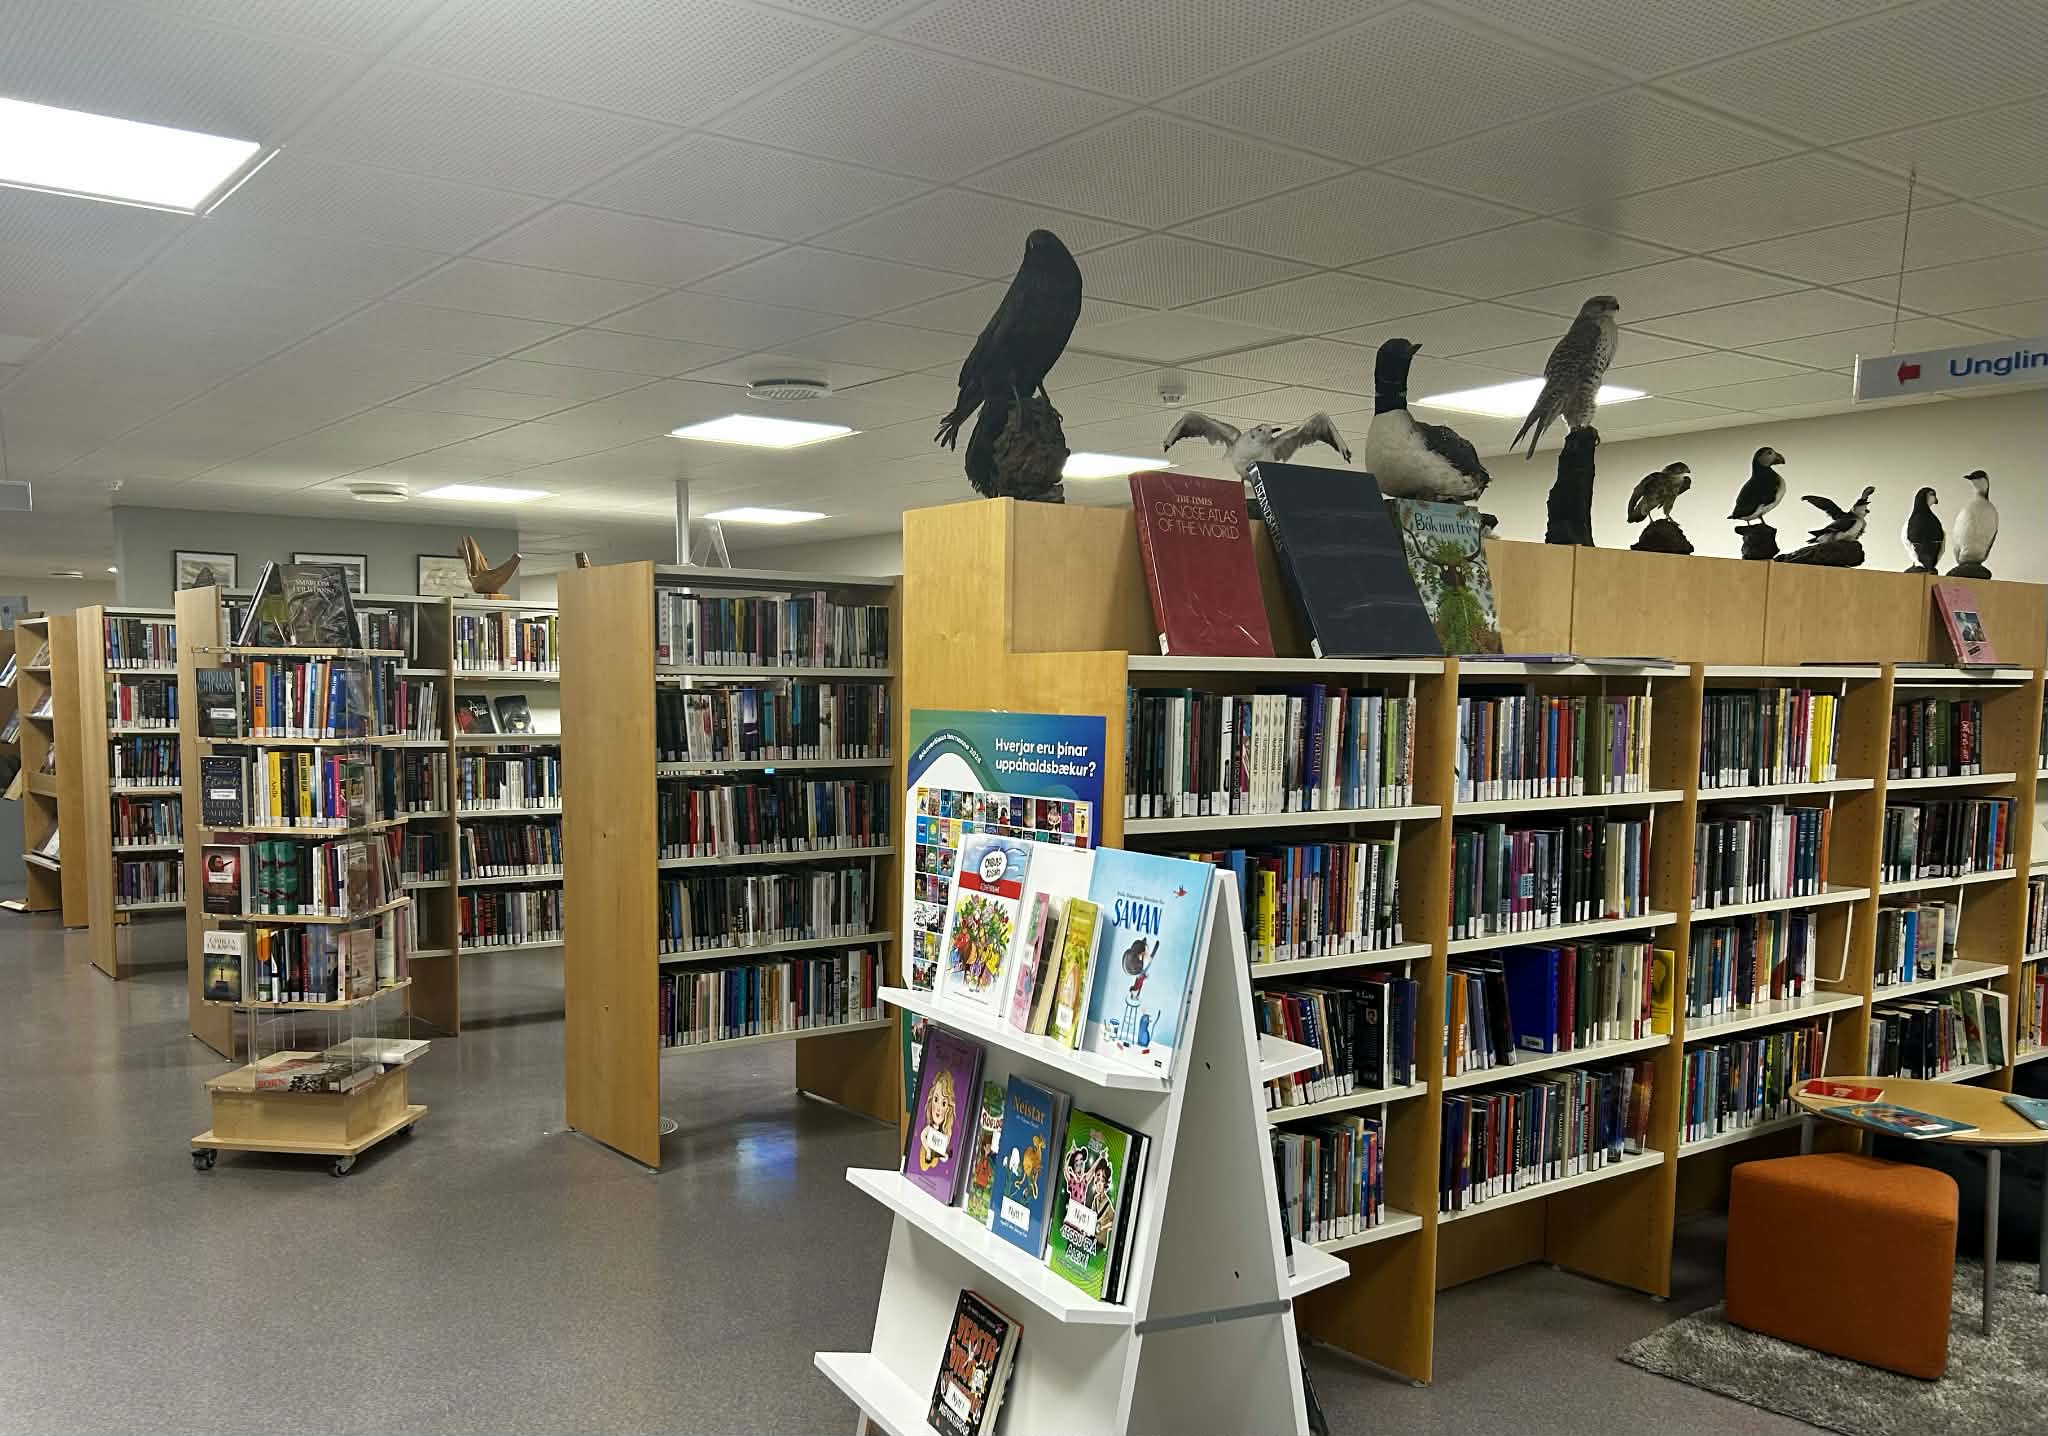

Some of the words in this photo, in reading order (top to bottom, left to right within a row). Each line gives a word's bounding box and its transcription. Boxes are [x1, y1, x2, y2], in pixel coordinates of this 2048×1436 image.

[1207, 508, 1238, 525] ATLAS
[1158, 517, 1174, 532] OF
[1176, 520, 1197, 536] THE
[1199, 523, 1240, 540] WORLD
[995, 737, 1036, 756] Hverjar
[1037, 742, 1055, 755] eru
[1057, 739, 1088, 759] þínar
[995, 757, 1096, 777] uppáhaldsbækur?
[1112, 898, 1163, 936] SAMAN
